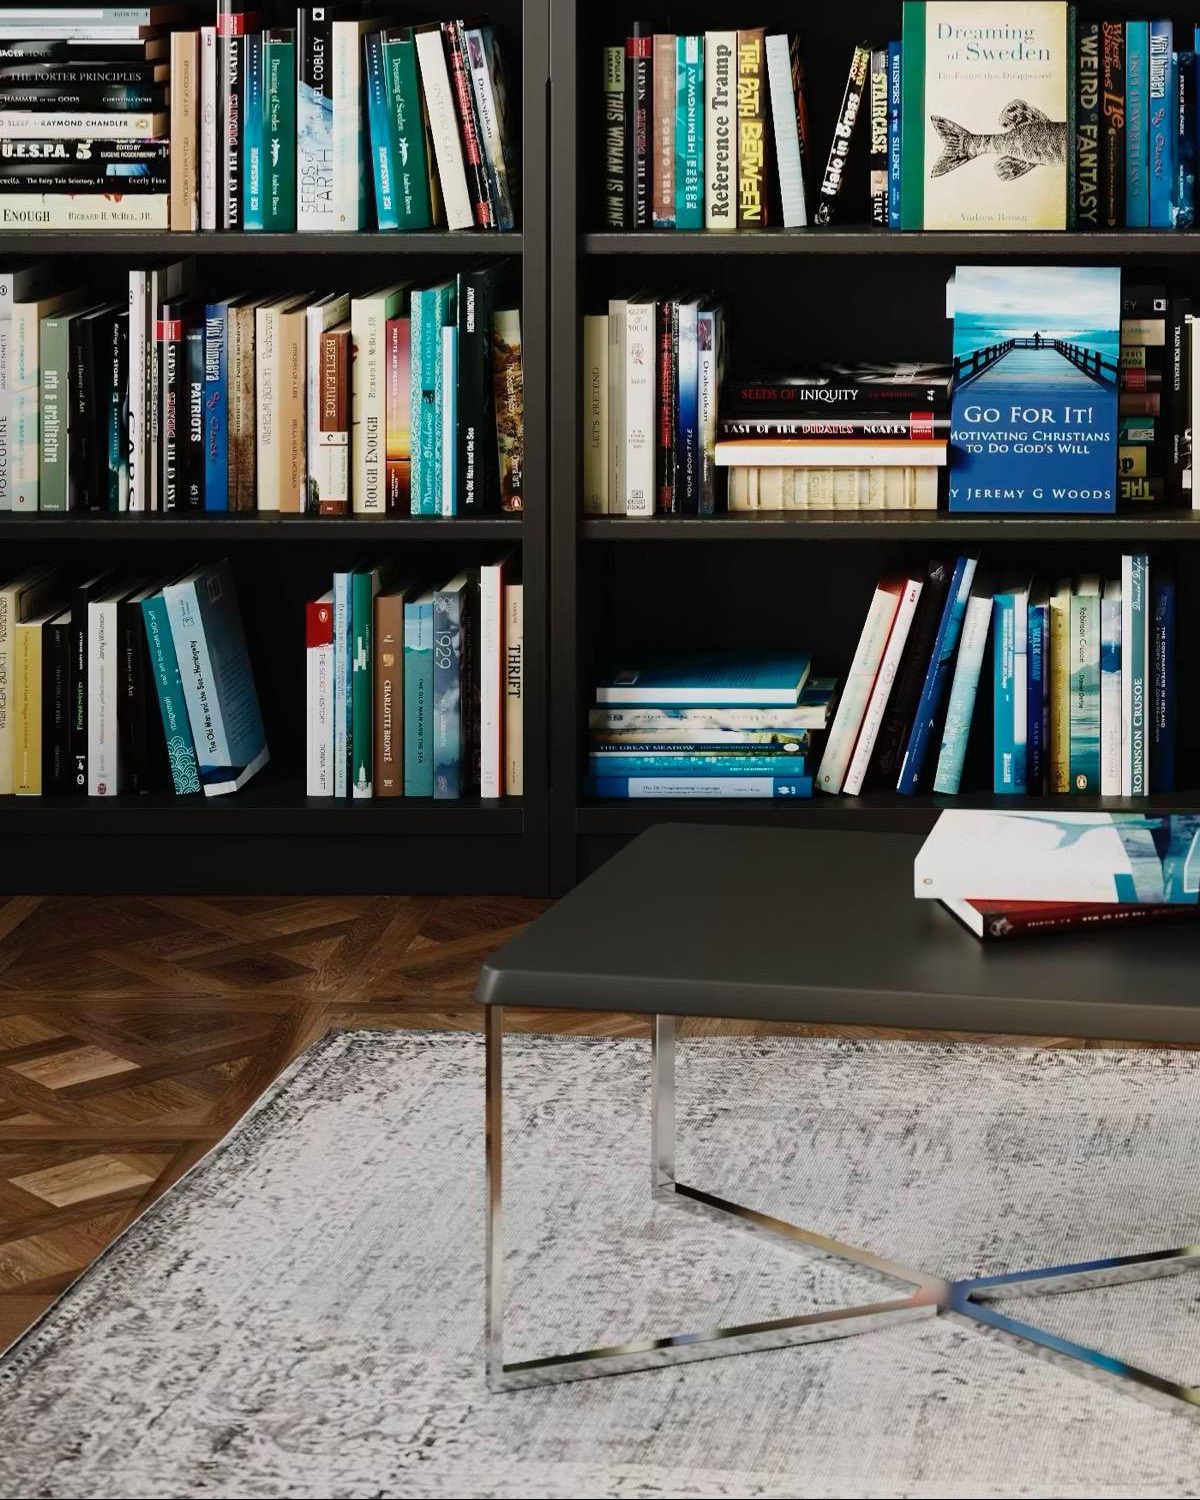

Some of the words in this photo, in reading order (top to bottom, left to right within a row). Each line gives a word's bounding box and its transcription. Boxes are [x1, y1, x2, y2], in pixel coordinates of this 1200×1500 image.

[938, 23, 1035, 42] Dreaming
[313, 37, 323, 80] COBLEY
[738, 40, 760, 74] THE
[947, 51, 960, 61] of
[966, 42, 1051, 61] Sweden
[12, 73, 31, 81] THE
[35, 73, 77, 81] PORTER
[80, 73, 141, 81] PRINCIPLES
[711, 44, 731, 110] Tramp
[313, 84, 323, 132] MICHAEL
[607, 93, 624, 120] THIS
[687, 67, 695, 153] HEMINGWAY
[737, 78, 759, 117] PATH
[2, 144, 69, 158] U.E.S.P.A.
[76, 143, 92, 159] 5
[607, 126, 624, 173] WOMAN
[662, 117, 670, 166] GANGS
[711, 116, 729, 217] Reference
[739, 121, 763, 220] BETWEEN
[821, 158, 844, 195] Halo
[833, 140, 848, 156] in
[607, 180, 624, 191] IS
[662, 172, 670, 204] GIRL
[3, 209, 50, 222] ENOUGH
[206, 318, 224, 338] Witi
[206, 340, 224, 381] Ihimaera
[44, 370, 59, 389] arts
[325, 340, 336, 417] BEETLEJUICE
[191, 383, 201, 442] PATRIOTS
[742, 390, 777, 399] SEEDS
[781, 390, 795, 399] OF
[801, 390, 859, 403] INIQUITY
[757, 424, 771, 434] OF
[776, 424, 797, 434] THE
[863, 424, 906, 434] NOAKES
[964, 406, 1000, 424] GO
[1010, 406, 1056, 424] FOR
[1064, 406, 1093, 424] IT!
[44, 405, 61, 463] architecture
[365, 417, 378, 463] ENOUGH
[966, 444, 983, 454] TO
[989, 444, 1008, 454] DO
[1014, 444, 1053, 454] GOD'S
[1058, 444, 1090, 454] WILL
[1033, 431, 1109, 442] CHRISTIANS
[365, 468, 378, 508] ROUGH
[967, 488, 1024, 500] JEREMY
[1032, 489, 1043, 499] G
[1053, 489, 1111, 499] WOODS
[1079, 607, 1087, 637] Robinson
[435, 631, 451, 669] 1929
[1079, 639, 1087, 663] Crusoe
[196, 678, 205, 690] Sea
[508, 645, 521, 698] THRIFT
[201, 703, 209, 713] and
[383, 680, 392, 728] CHARLOTTE
[1133, 678, 1143, 727] CRUSOE
[203, 714, 212, 727] Man
[206, 728, 215, 740] Old
[209, 741, 217, 753] The
[383, 730, 393, 762] BRONTË
[1133, 730, 1143, 793] ROBINSON
